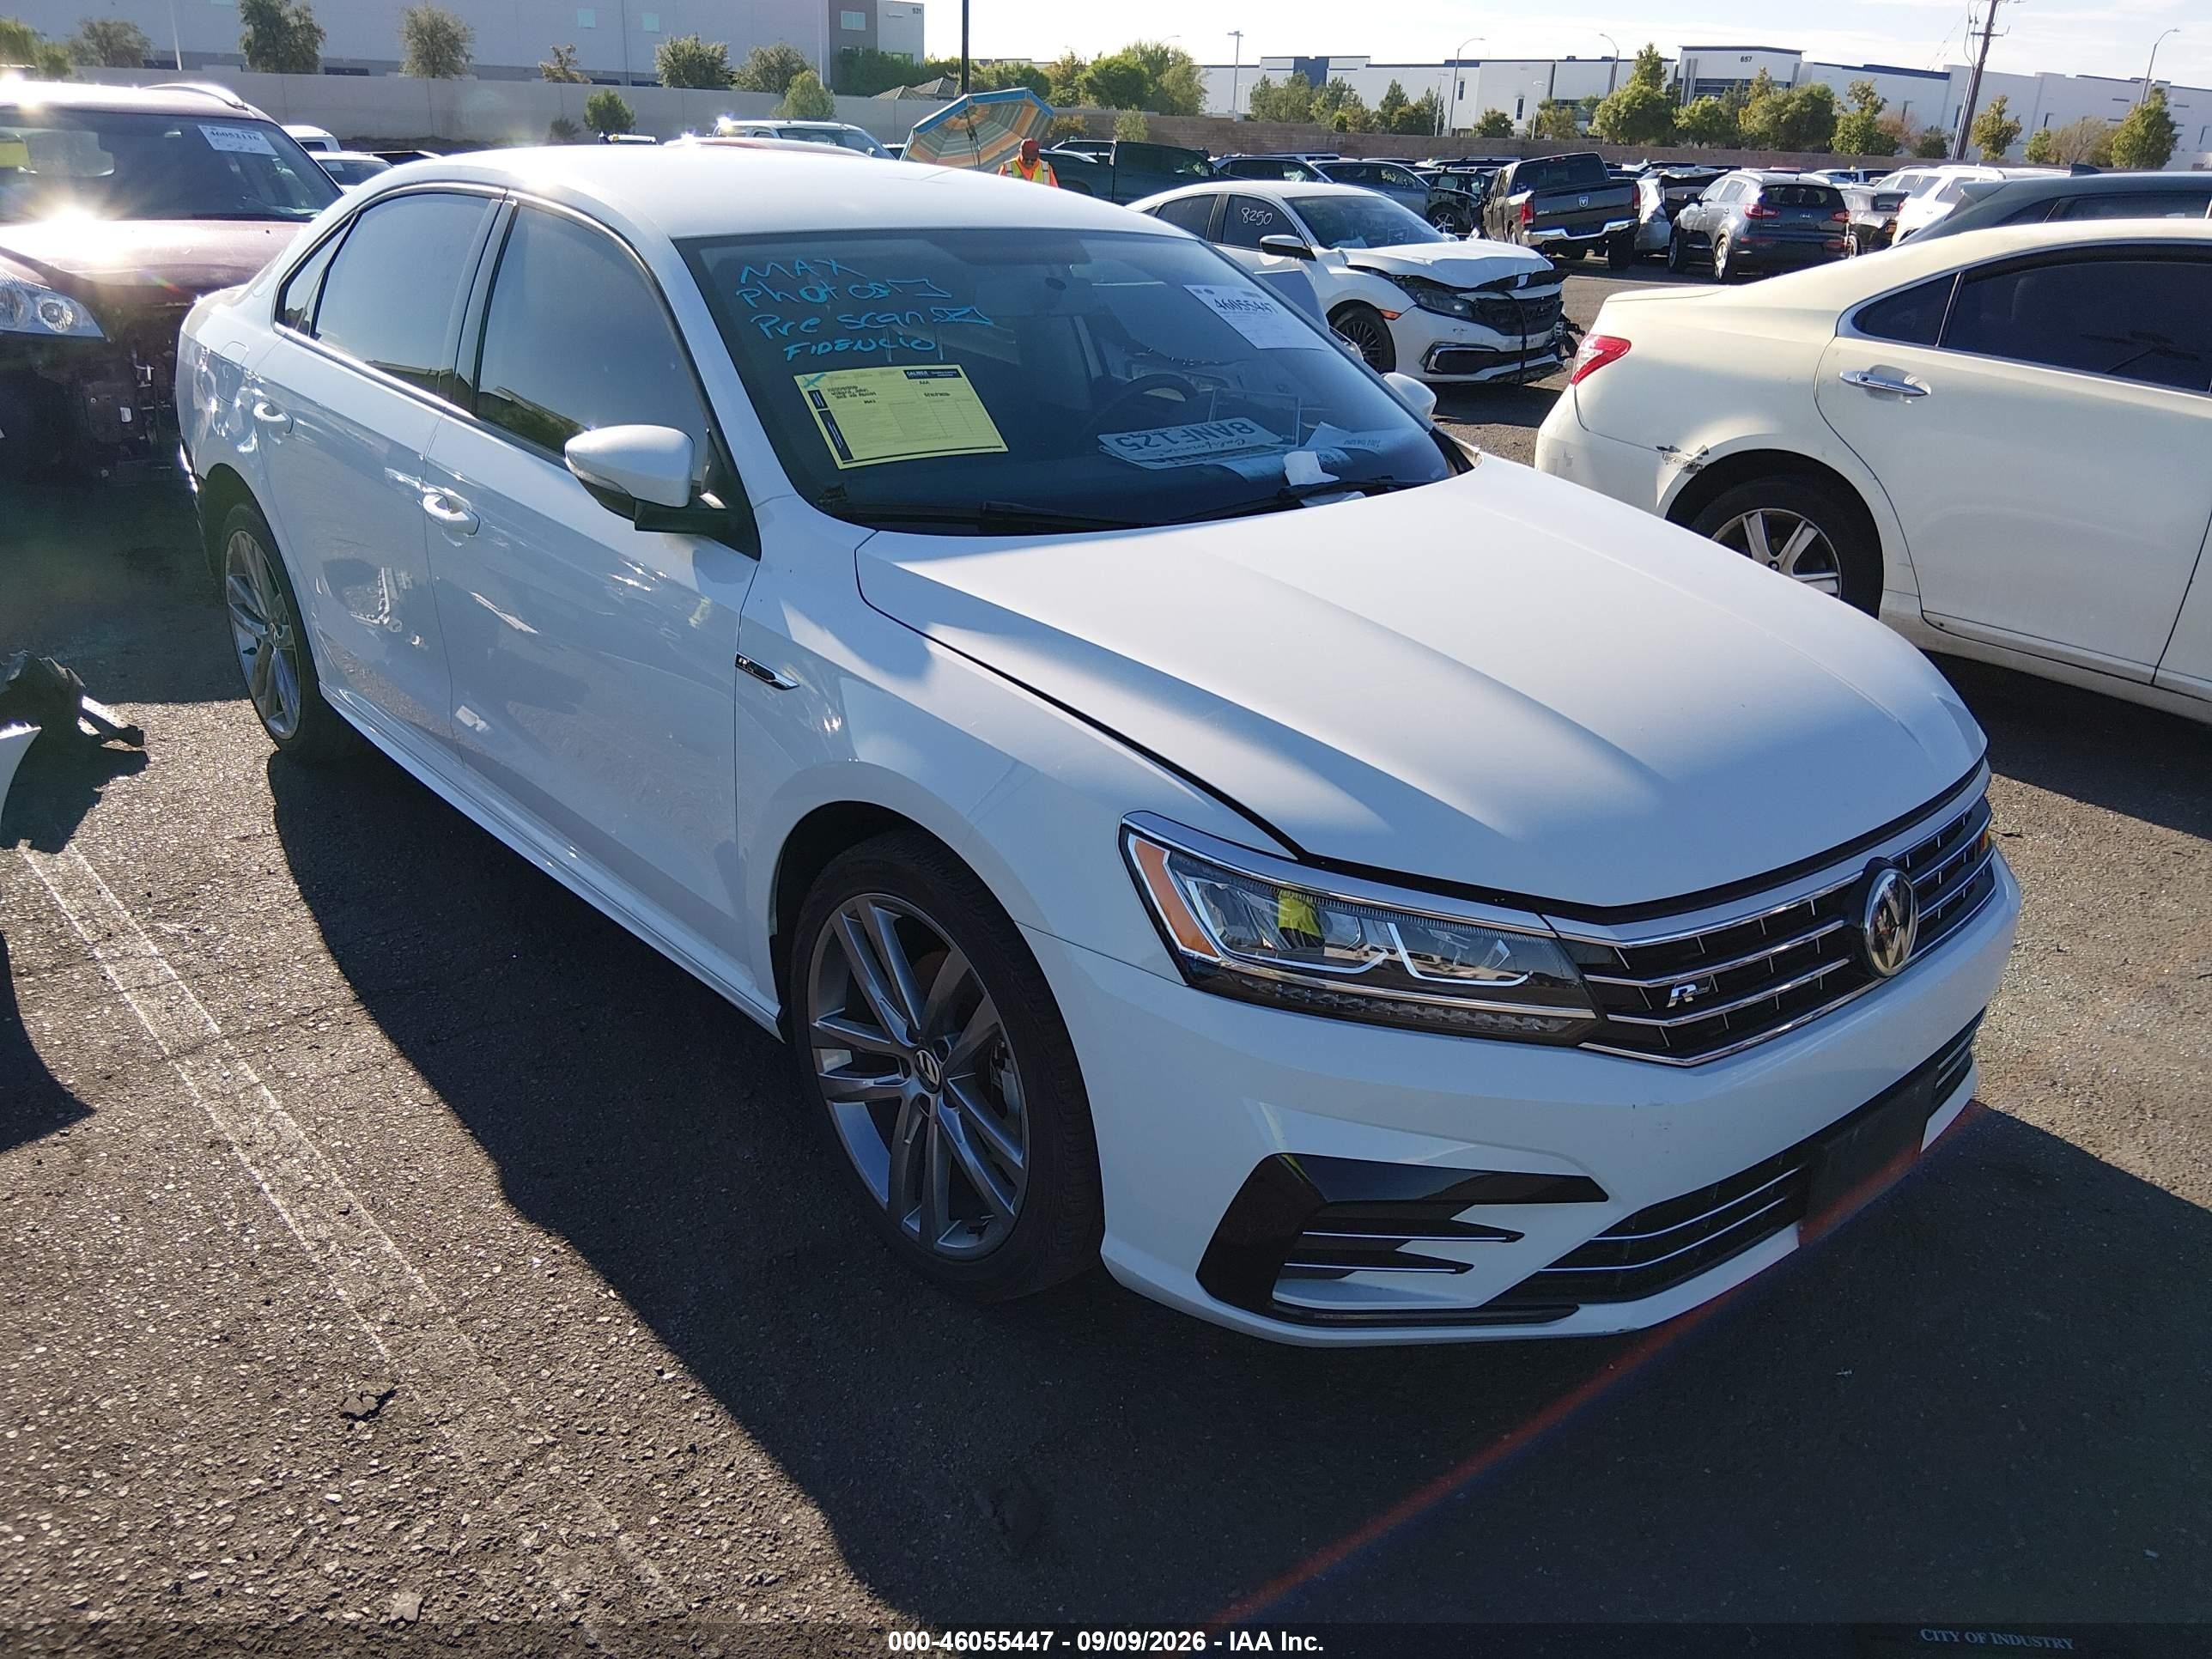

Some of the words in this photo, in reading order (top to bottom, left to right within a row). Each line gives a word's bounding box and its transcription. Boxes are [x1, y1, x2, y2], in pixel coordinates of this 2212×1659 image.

[1241, 207, 1273, 226] 8250
[740, 259, 867, 283] MAX
[1214, 299, 1278, 314] 46055447
[750, 314, 822, 339] Pre
[1115, 422, 1255, 452] 8ANF125
[1920, 1628, 1960, 1643] CITY
[1965, 1632, 1987, 1644] OF
[1990, 1632, 2075, 1650] INDUSTRY
